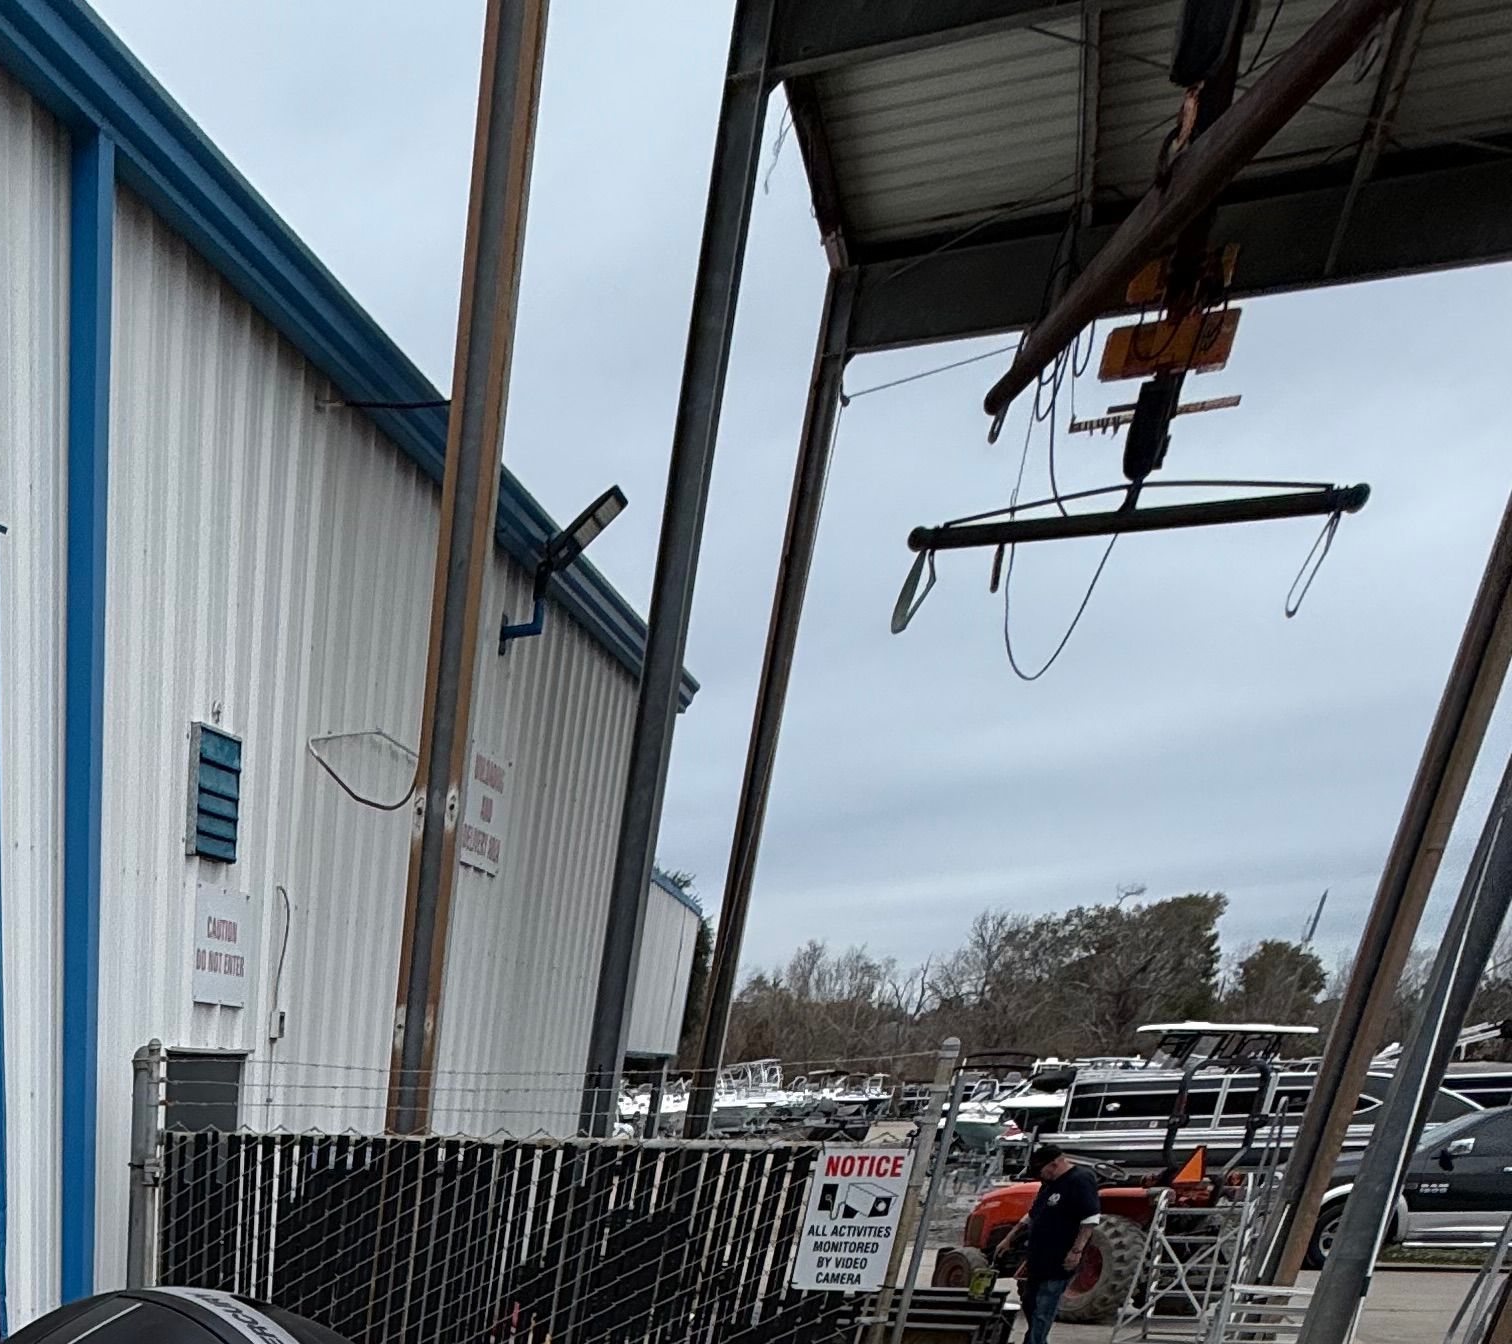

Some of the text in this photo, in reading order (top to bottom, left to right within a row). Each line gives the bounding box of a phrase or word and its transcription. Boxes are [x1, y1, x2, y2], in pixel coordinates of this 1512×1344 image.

[207, 915, 238, 944] CAUTION
[196, 948, 245, 977] DO NOT ENTER
[824, 1155, 905, 1178] NOTICE
[807, 1225, 892, 1237] ALL ACTIVITIES
[812, 1241, 879, 1254] MONITORED
[816, 1256, 868, 1269] BY VIDEO
[815, 1272, 861, 1285] CAMERA
